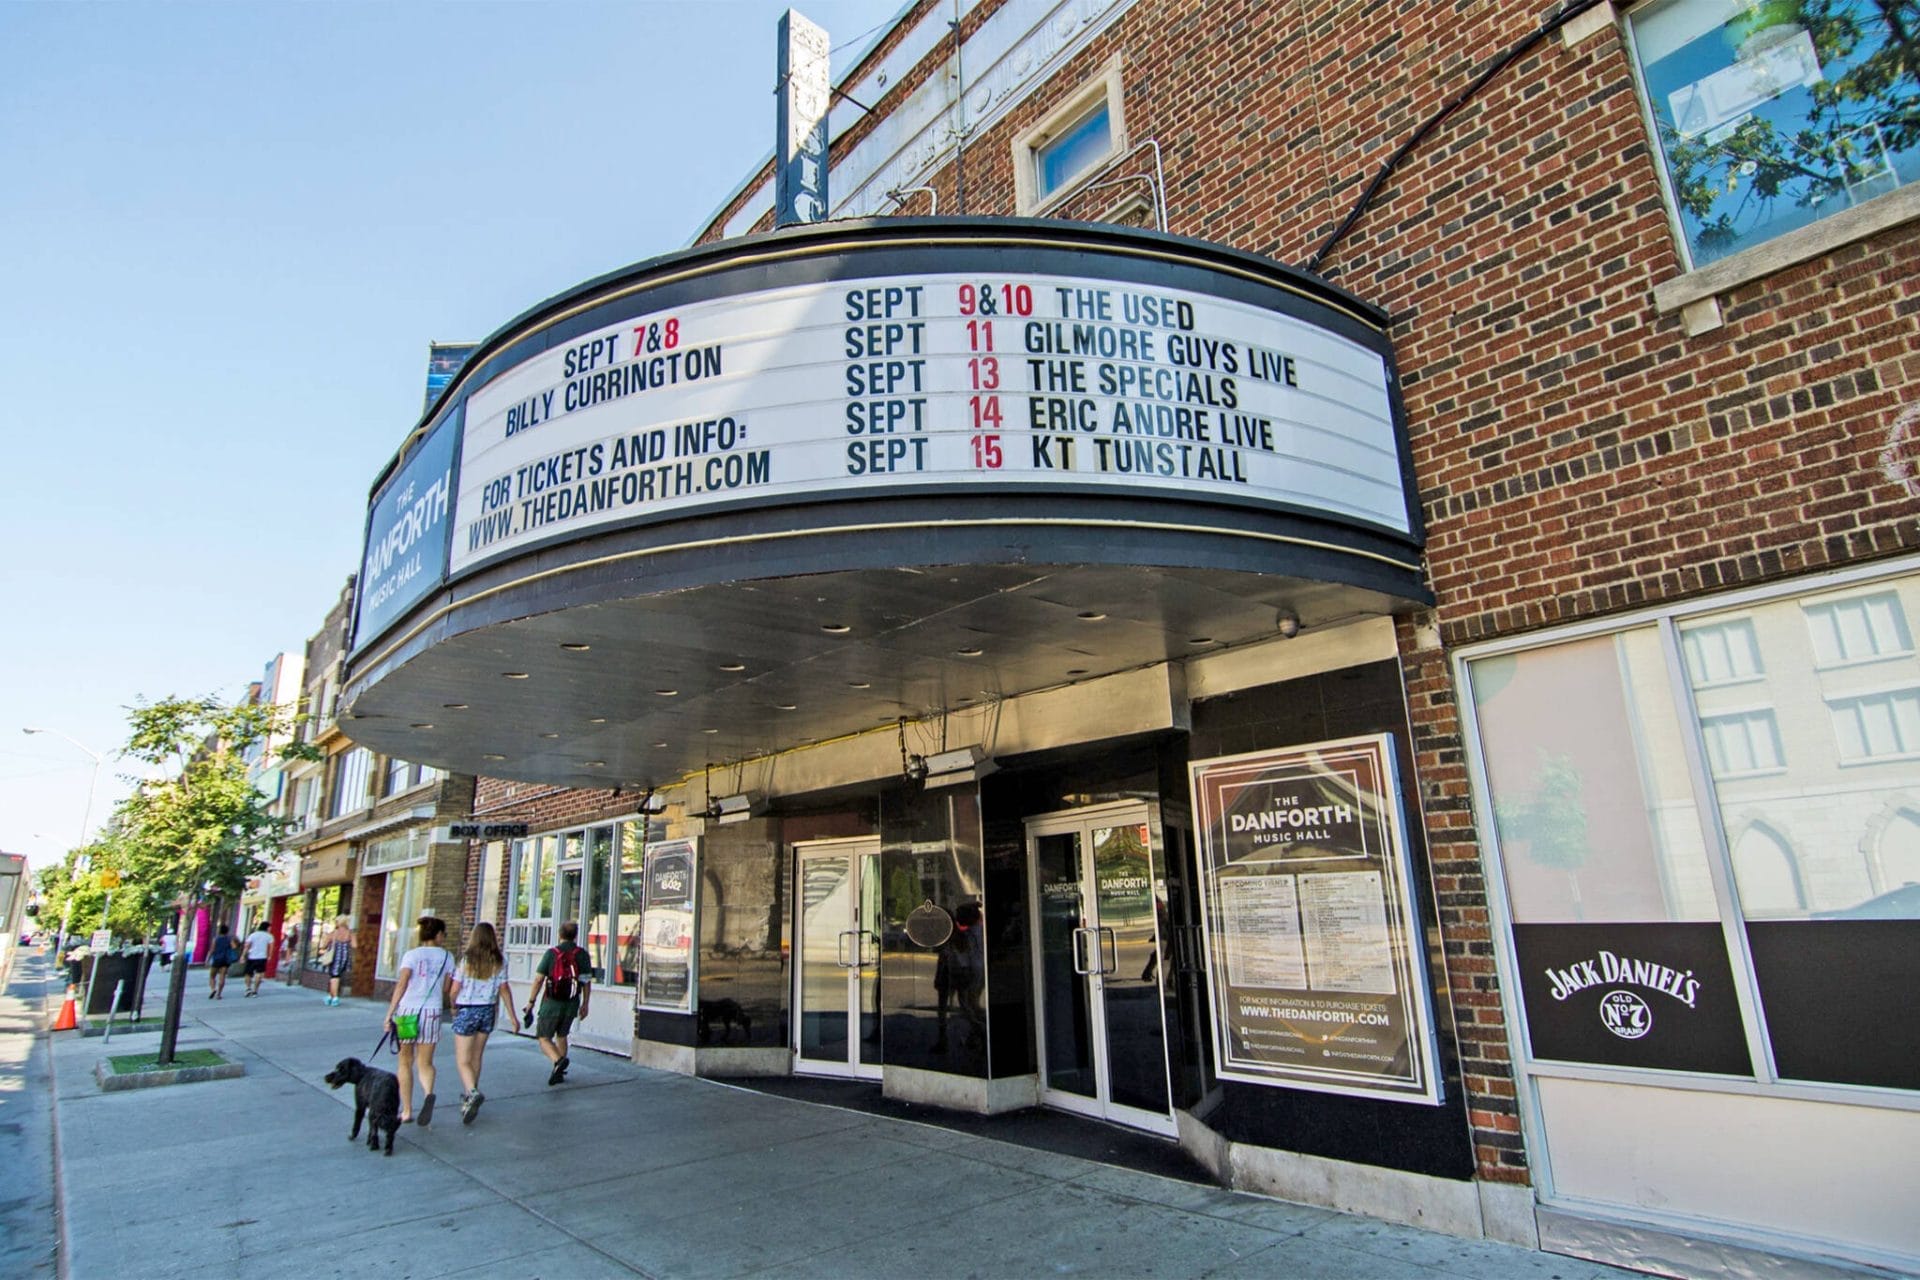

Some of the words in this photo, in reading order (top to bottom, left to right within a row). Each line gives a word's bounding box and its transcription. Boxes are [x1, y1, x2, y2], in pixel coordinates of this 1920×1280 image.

[846, 286, 923, 321] SEPT
[959, 283, 1033, 316] 9&10
[1056, 287, 1110, 320] THE
[1123, 294, 1194, 331] USED
[564, 334, 618, 378] SEPT
[633, 318, 680, 356] 7&8
[845, 323, 925, 358] SEPT
[966, 320, 993, 352] 11
[1025, 322, 1153, 361] GILMORE
[1167, 334, 1238, 374] GUYS
[1249, 348, 1297, 387] LIVE
[505, 390, 554, 438] BILLY
[565, 345, 722, 411] CURRINGTON
[846, 360, 926, 396] SEPT
[967, 357, 1000, 390] 13
[1027, 359, 1086, 393] THE
[1100, 363, 1238, 409] SPECIALS
[846, 399, 926, 434] SEPT
[969, 395, 1003, 428] 14
[1029, 396, 1097, 432] ERIC
[1113, 402, 1208, 442] ANDRE
[1220, 413, 1274, 451] LIVE
[481, 475, 511, 514] FOR
[517, 444, 603, 496] TICKETS
[611, 430, 665, 471] AND
[675, 417, 747, 457] INFO:
[847, 438, 928, 475] SEPT
[970, 435, 1003, 468] 15
[1032, 436, 1074, 470] KT
[1093, 438, 1247, 483] TUNSTALL
[396, 480, 416, 514] THE
[469, 450, 770, 551] WWW.THEDANFORTH.COM
[363, 469, 451, 595] DANFORTH
[369, 574, 396, 612] MUSIC
[397, 552, 422, 584] HALL
[1231, 804, 1352, 832] DANFORTH
[1274, 796, 1299, 807] THE
[451, 824, 480, 837] BOX
[483, 824, 529, 837] OFFICE
[1253, 832, 1292, 844] MUSIC
[1296, 829, 1331, 841] HALL
[1102, 877, 1148, 889] DANFORTH
[1545, 959, 1602, 1001] JACK
[1599, 950, 1701, 1008] DANIEL'S
[1612, 994, 1633, 1003] OLD
[1240, 1005, 1389, 1026] WWW.THEDANFORTH.COM
